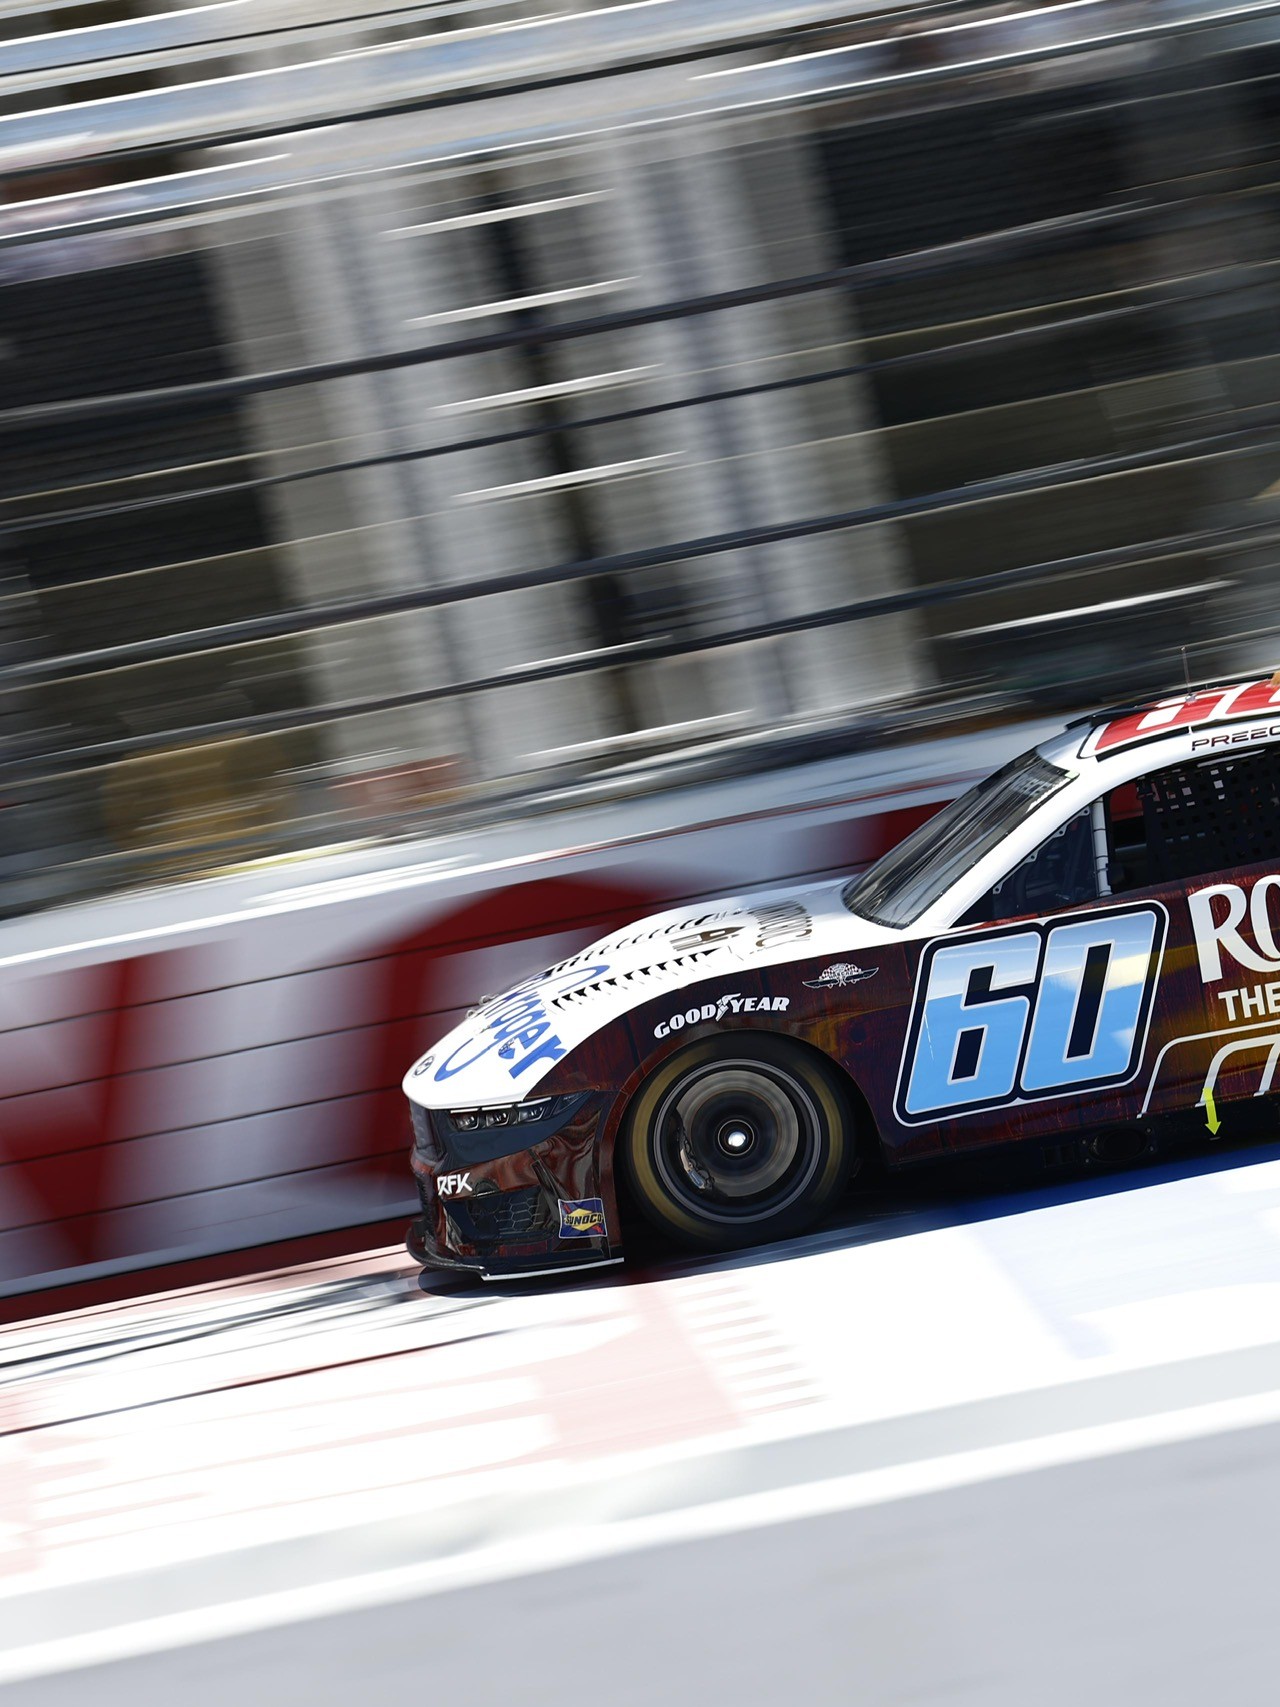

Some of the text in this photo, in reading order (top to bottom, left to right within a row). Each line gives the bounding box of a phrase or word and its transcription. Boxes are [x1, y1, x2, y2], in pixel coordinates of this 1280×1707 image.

[653, 995, 790, 1040] GOODYEAR
[903, 909, 1159, 1117] 60
[436, 1172, 473, 1196] RFK
[564, 1212, 603, 1226] SUNOCO
